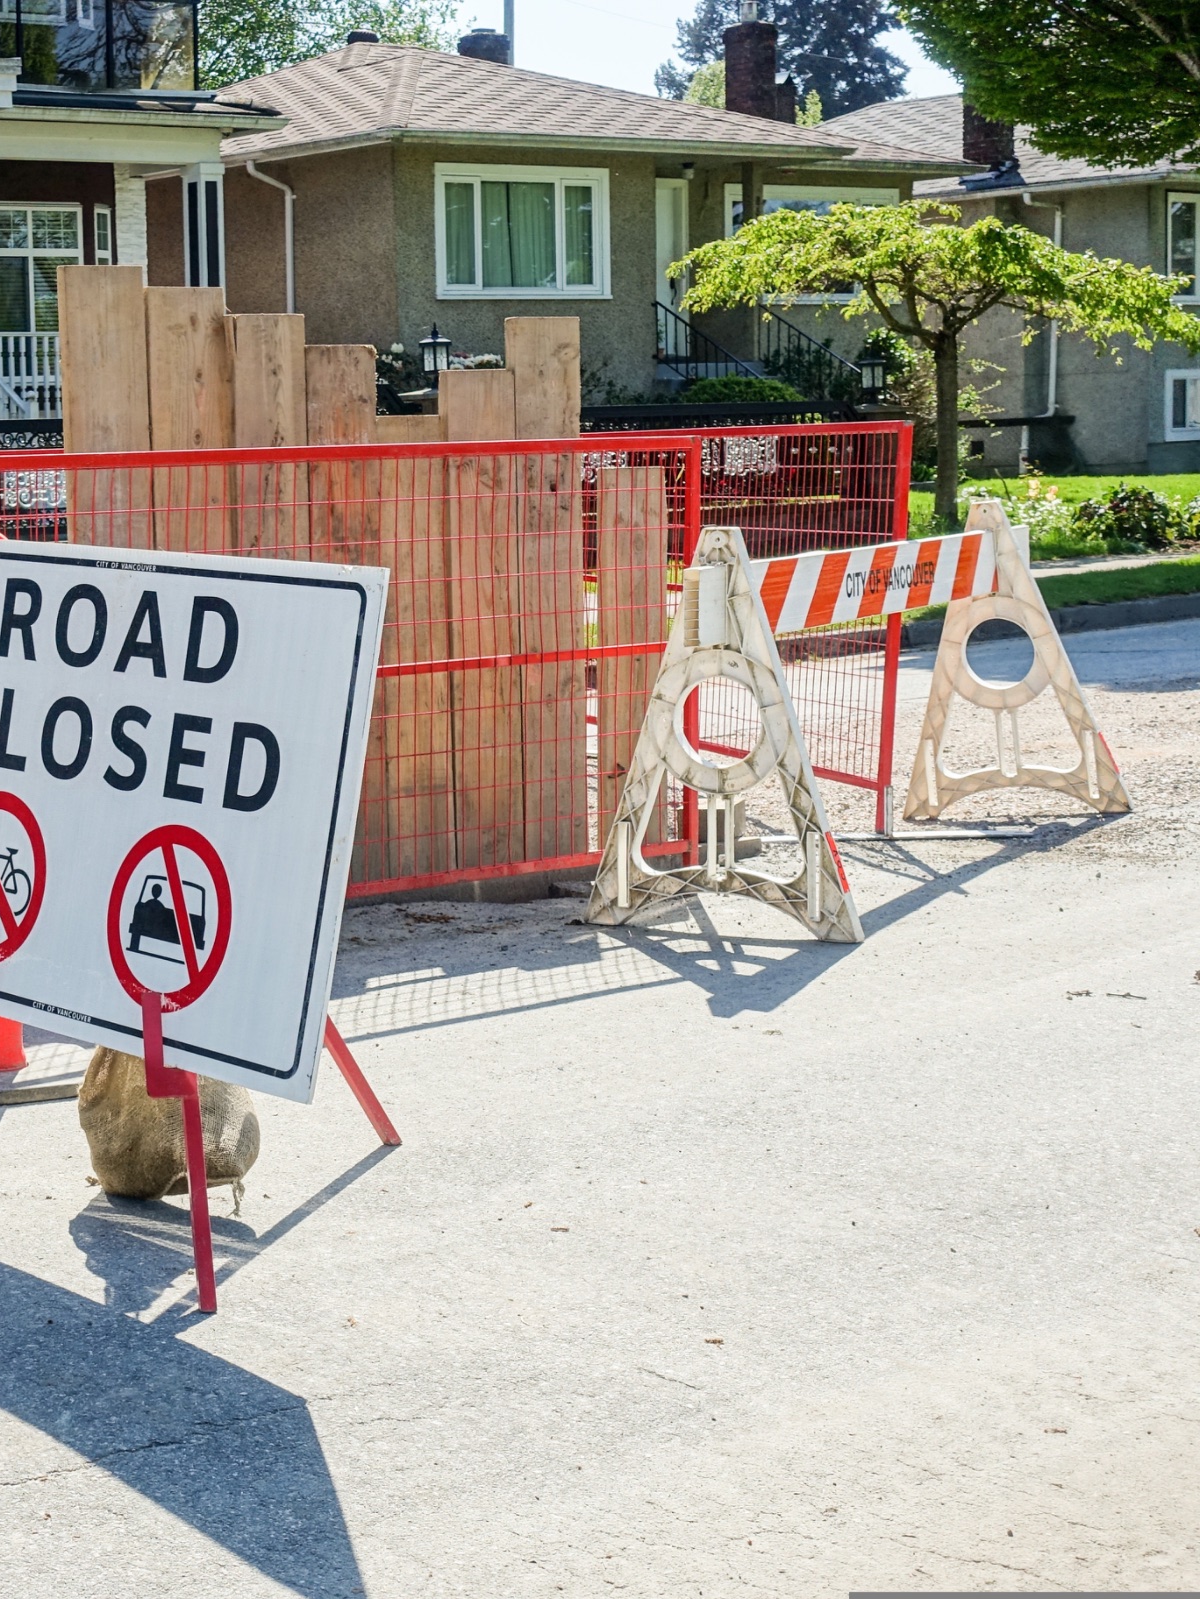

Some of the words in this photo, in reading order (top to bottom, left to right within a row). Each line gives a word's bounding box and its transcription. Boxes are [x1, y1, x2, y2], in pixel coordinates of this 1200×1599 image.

[95, 560, 109, 568] CITY
[110, 561, 119, 569] OF
[121, 562, 157, 572] VANCOUVER
[845, 570, 867, 598] CITY
[868, 568, 881, 595] OF
[883, 561, 935, 591] VANCOUVER
[32, 1001, 46, 1010] CITY
[46, 1005, 55, 1013] OF
[57, 1007, 92, 1023] VANCOUVER
